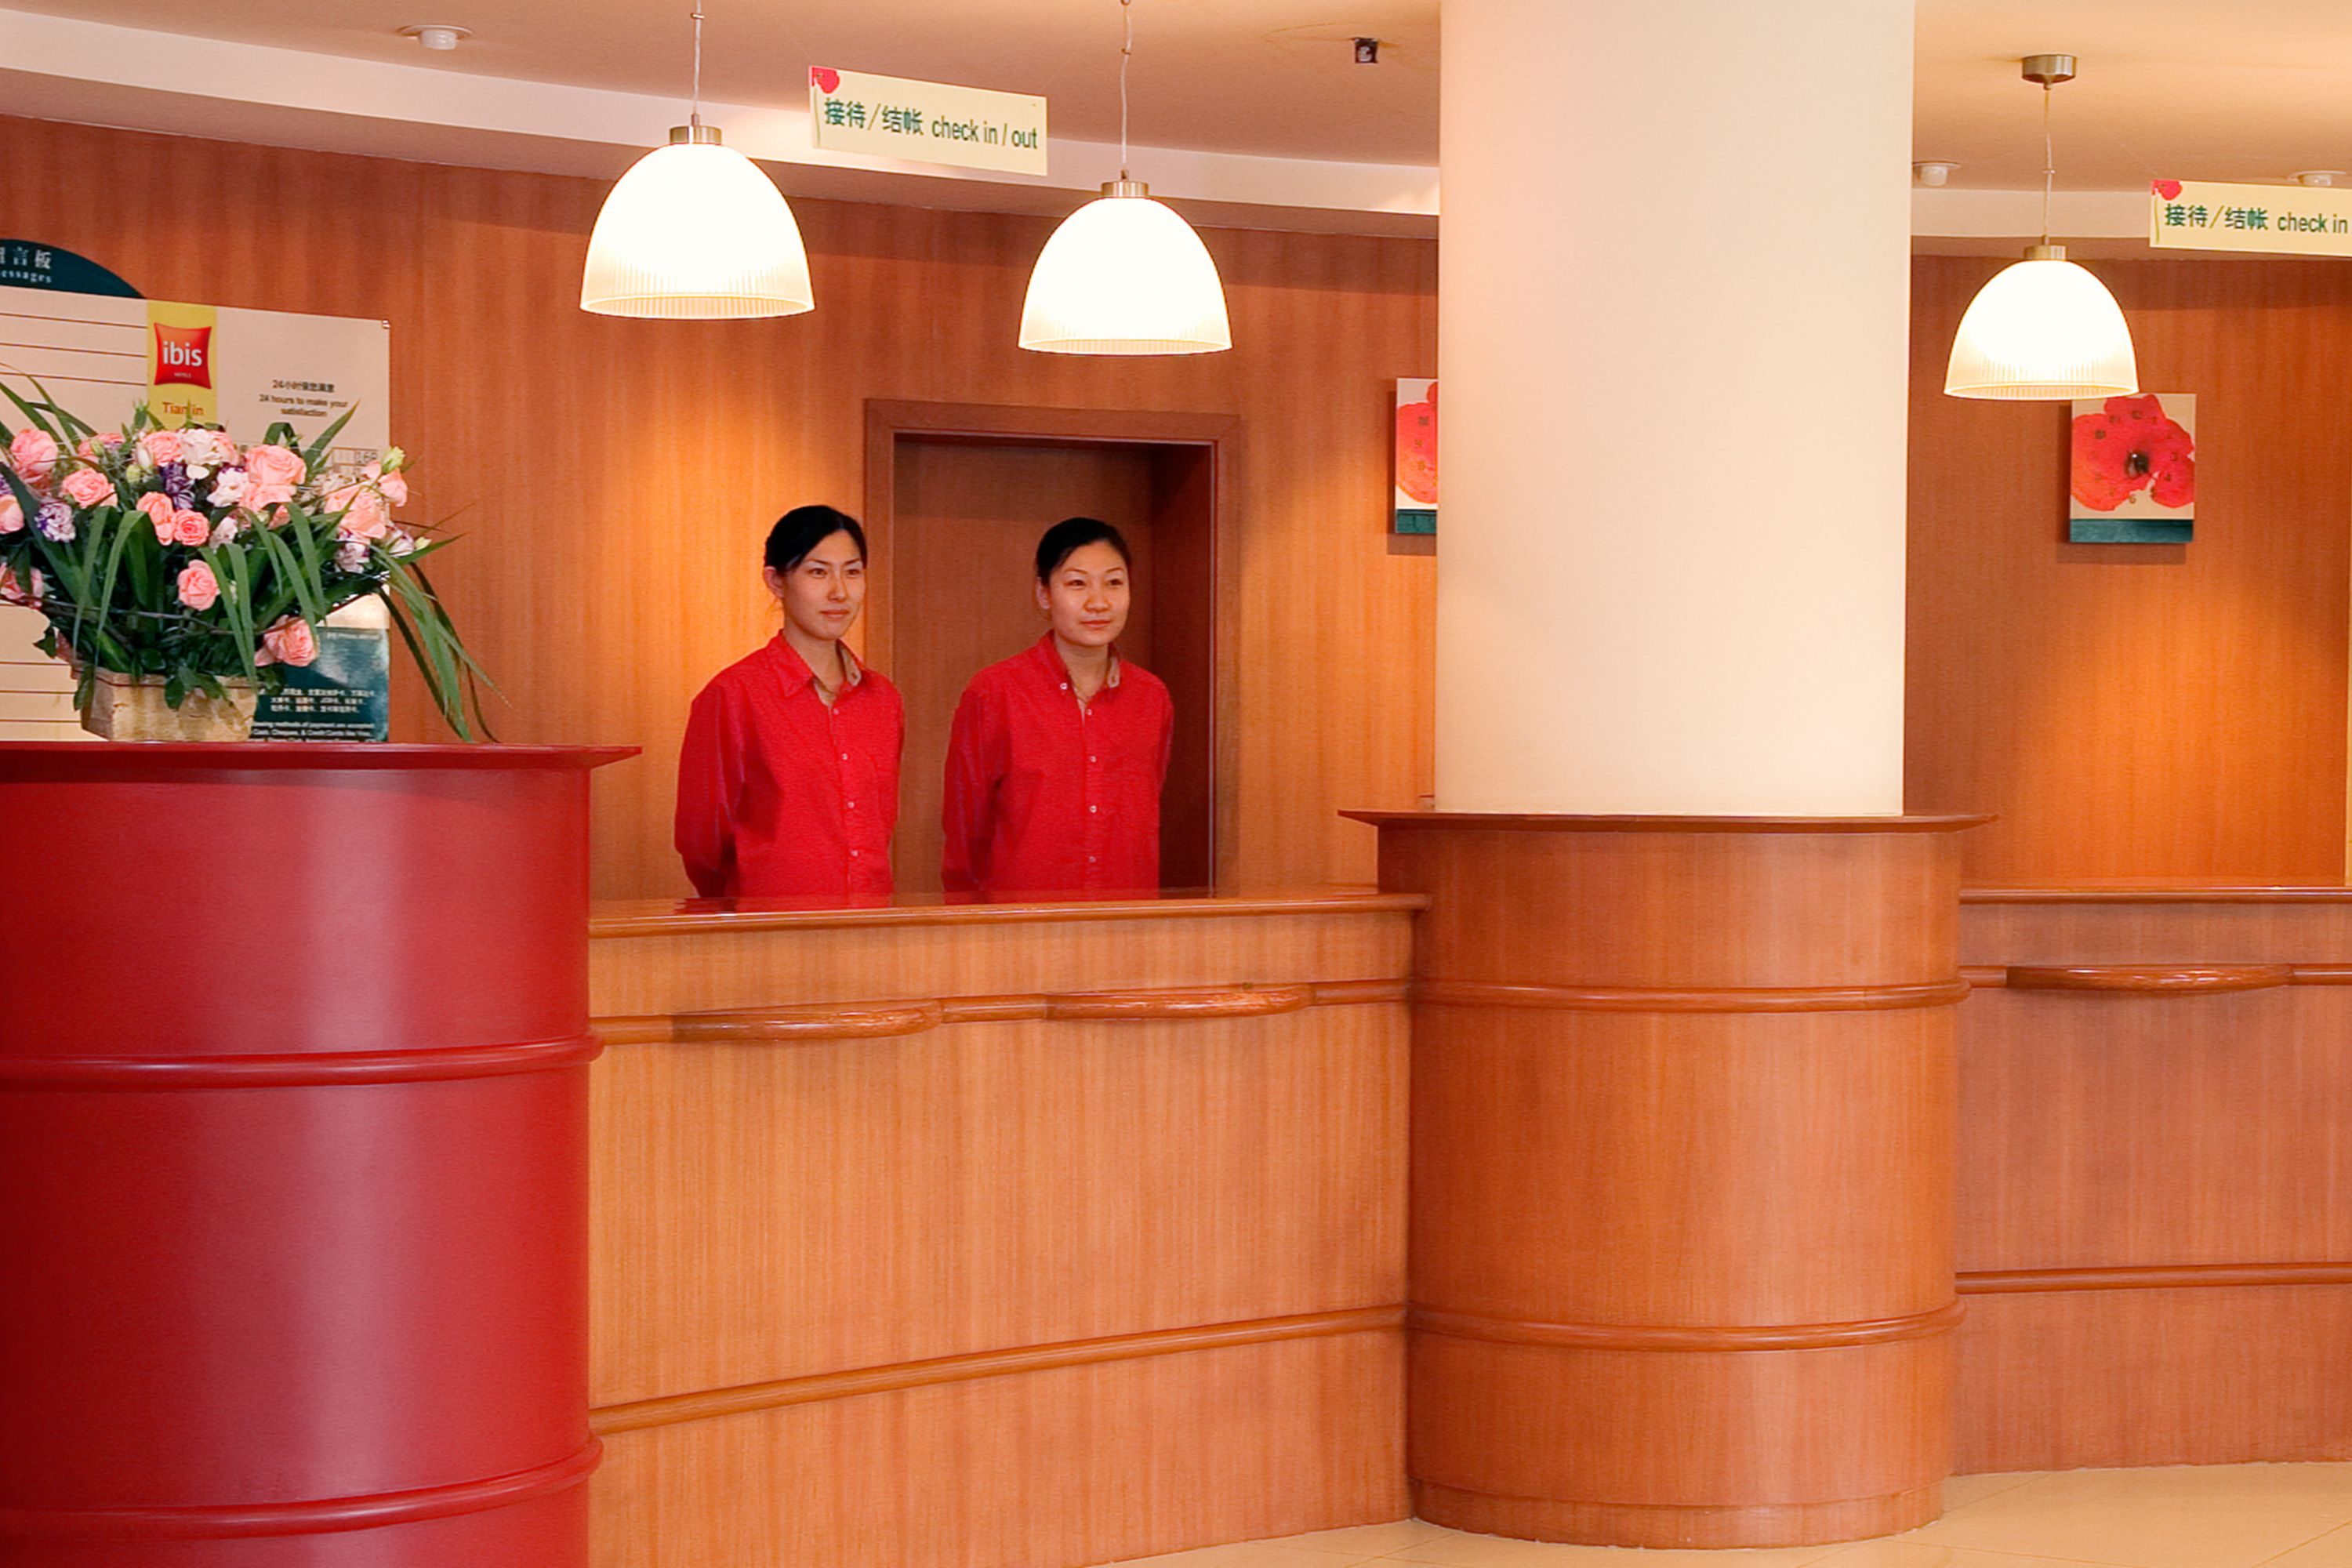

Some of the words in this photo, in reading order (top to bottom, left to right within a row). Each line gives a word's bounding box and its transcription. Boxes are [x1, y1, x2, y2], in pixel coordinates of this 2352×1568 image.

[932, 115, 979, 143] check
[2278, 212, 2328, 233] check
[2332, 213, 2348, 234] in
[0, 246, 52, 269] 言板
[0, 270, 52, 284] essages
[163, 340, 202, 367] ibis
[162, 401, 204, 416] Tianin
[271, 395, 294, 404] hours
